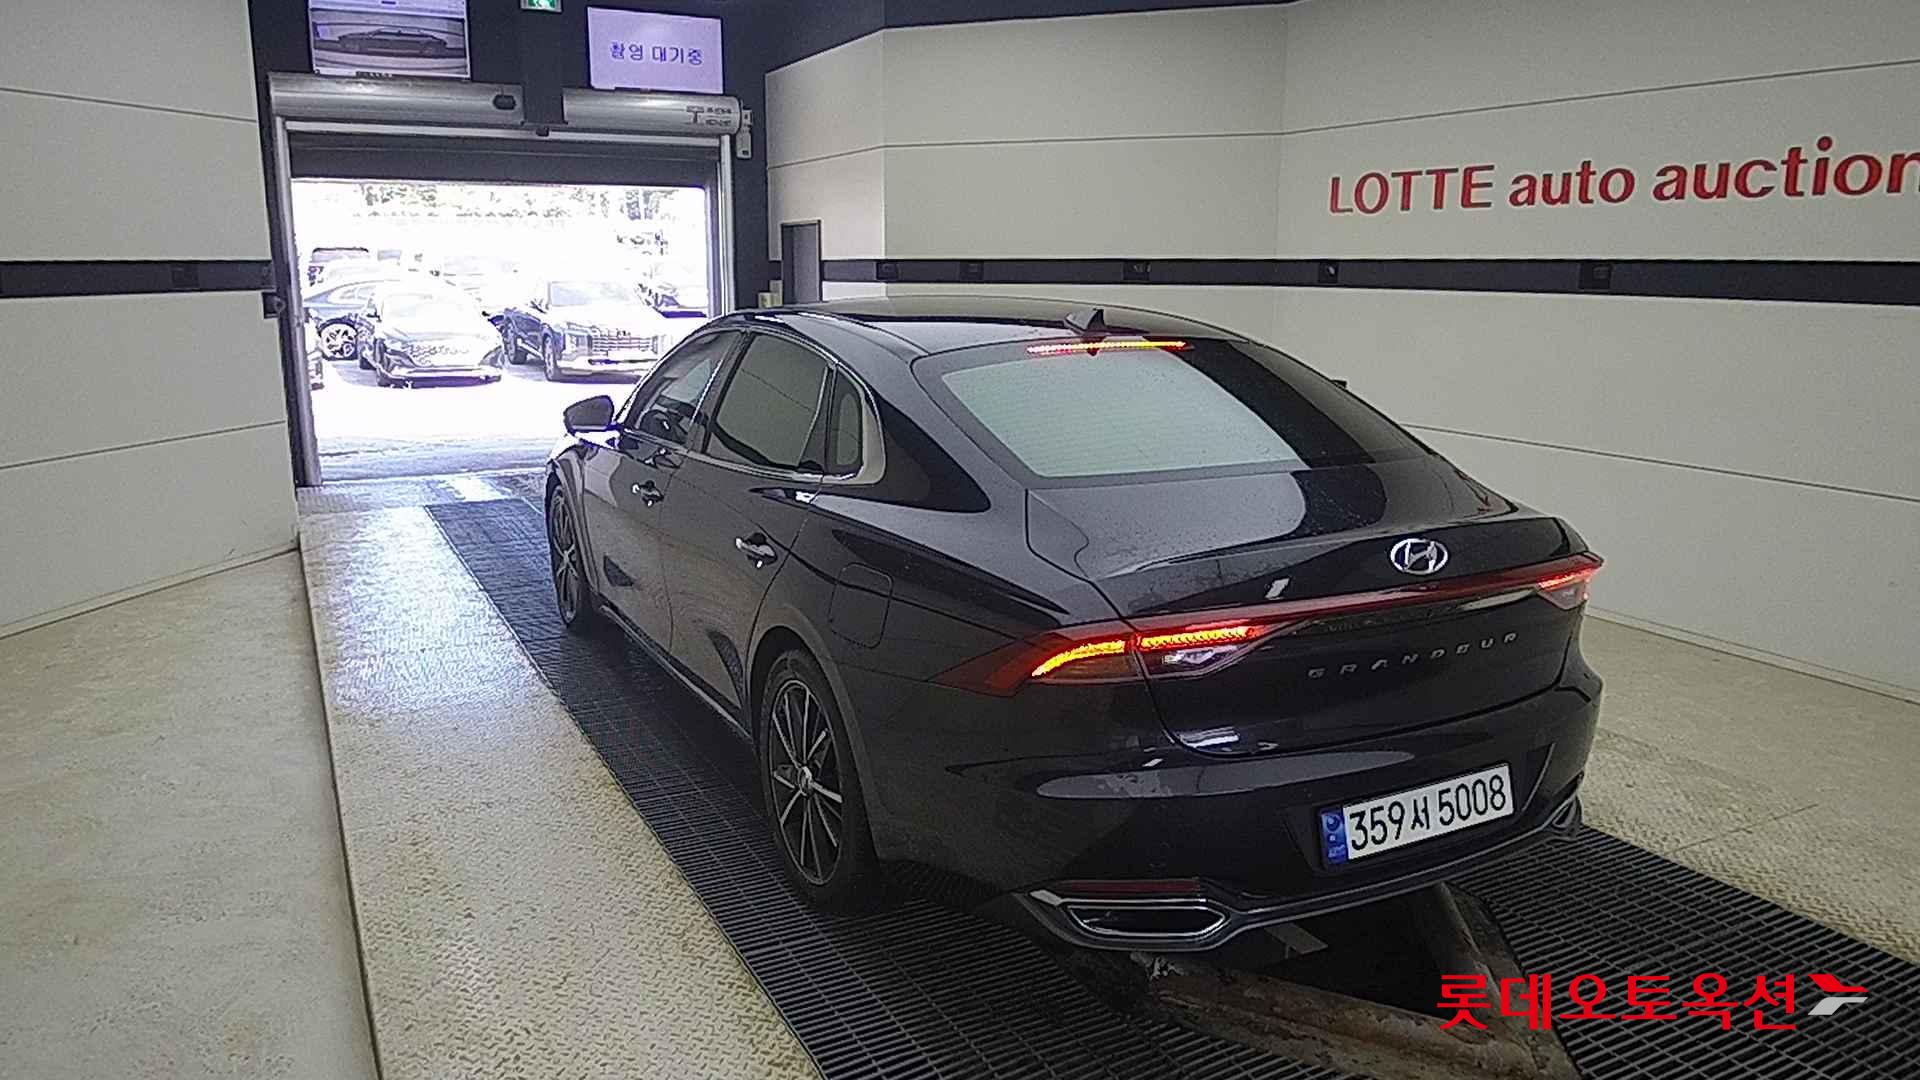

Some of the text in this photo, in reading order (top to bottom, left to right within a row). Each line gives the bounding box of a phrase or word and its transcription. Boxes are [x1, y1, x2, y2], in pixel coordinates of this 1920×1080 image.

[652, 46, 703, 65] 대기중
[1330, 136, 1920, 214] LOTTE auto auction
[1308, 632, 1518, 679] GRANDEUR
